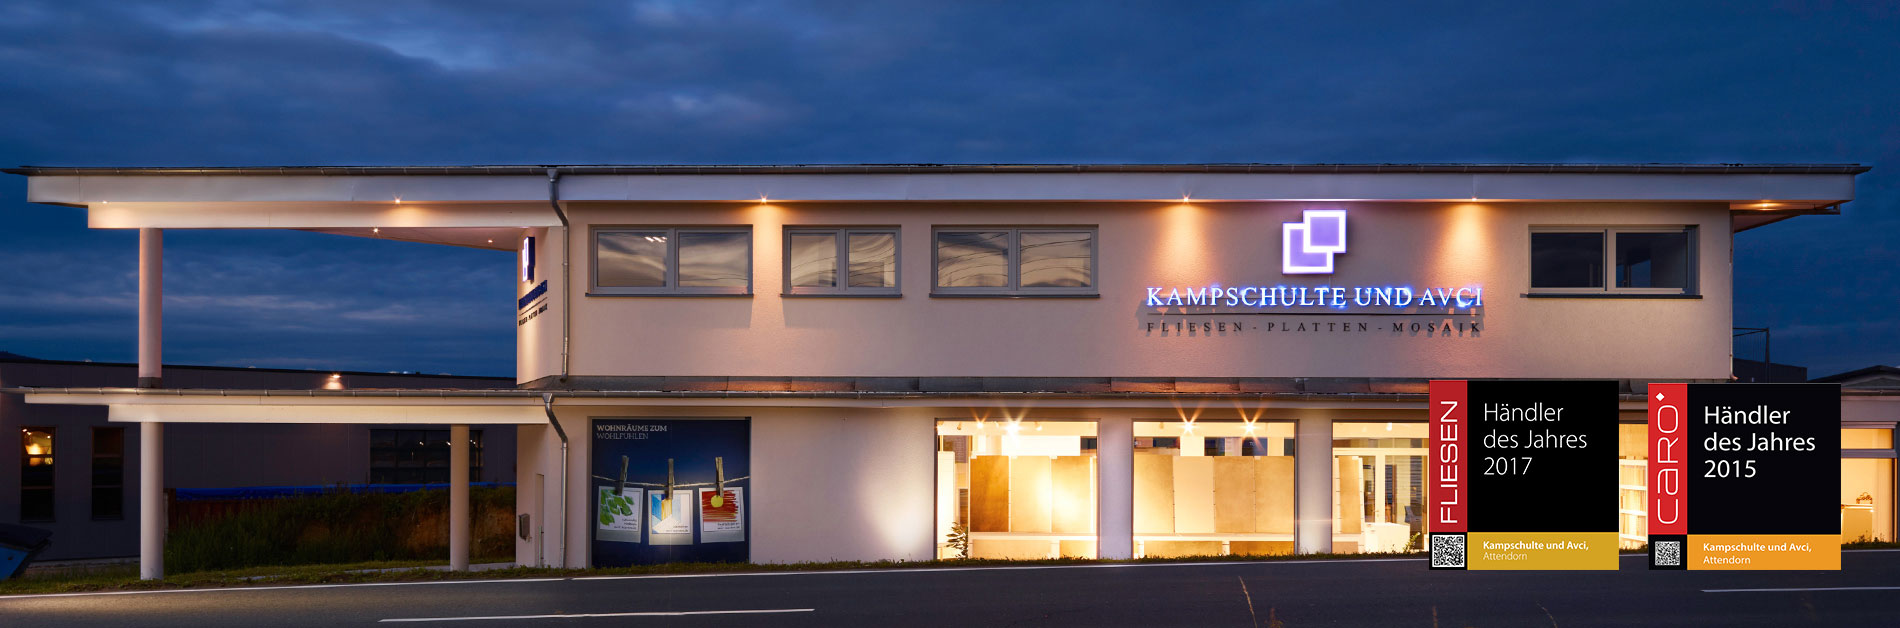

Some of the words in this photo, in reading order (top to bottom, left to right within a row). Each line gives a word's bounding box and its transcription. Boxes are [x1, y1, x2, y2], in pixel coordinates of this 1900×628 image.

[1146, 287, 1346, 307] KAMPSCHULTE
[1354, 287, 1412, 306] UND
[1419, 287, 1483, 307] AVCI
[1147, 322, 1242, 332] FLIESEN
[1267, 322, 1368, 332] PLATTEN
[1392, 322, 1481, 332] MOSAIK
[596, 424, 648, 432] WOHNRÄUME
